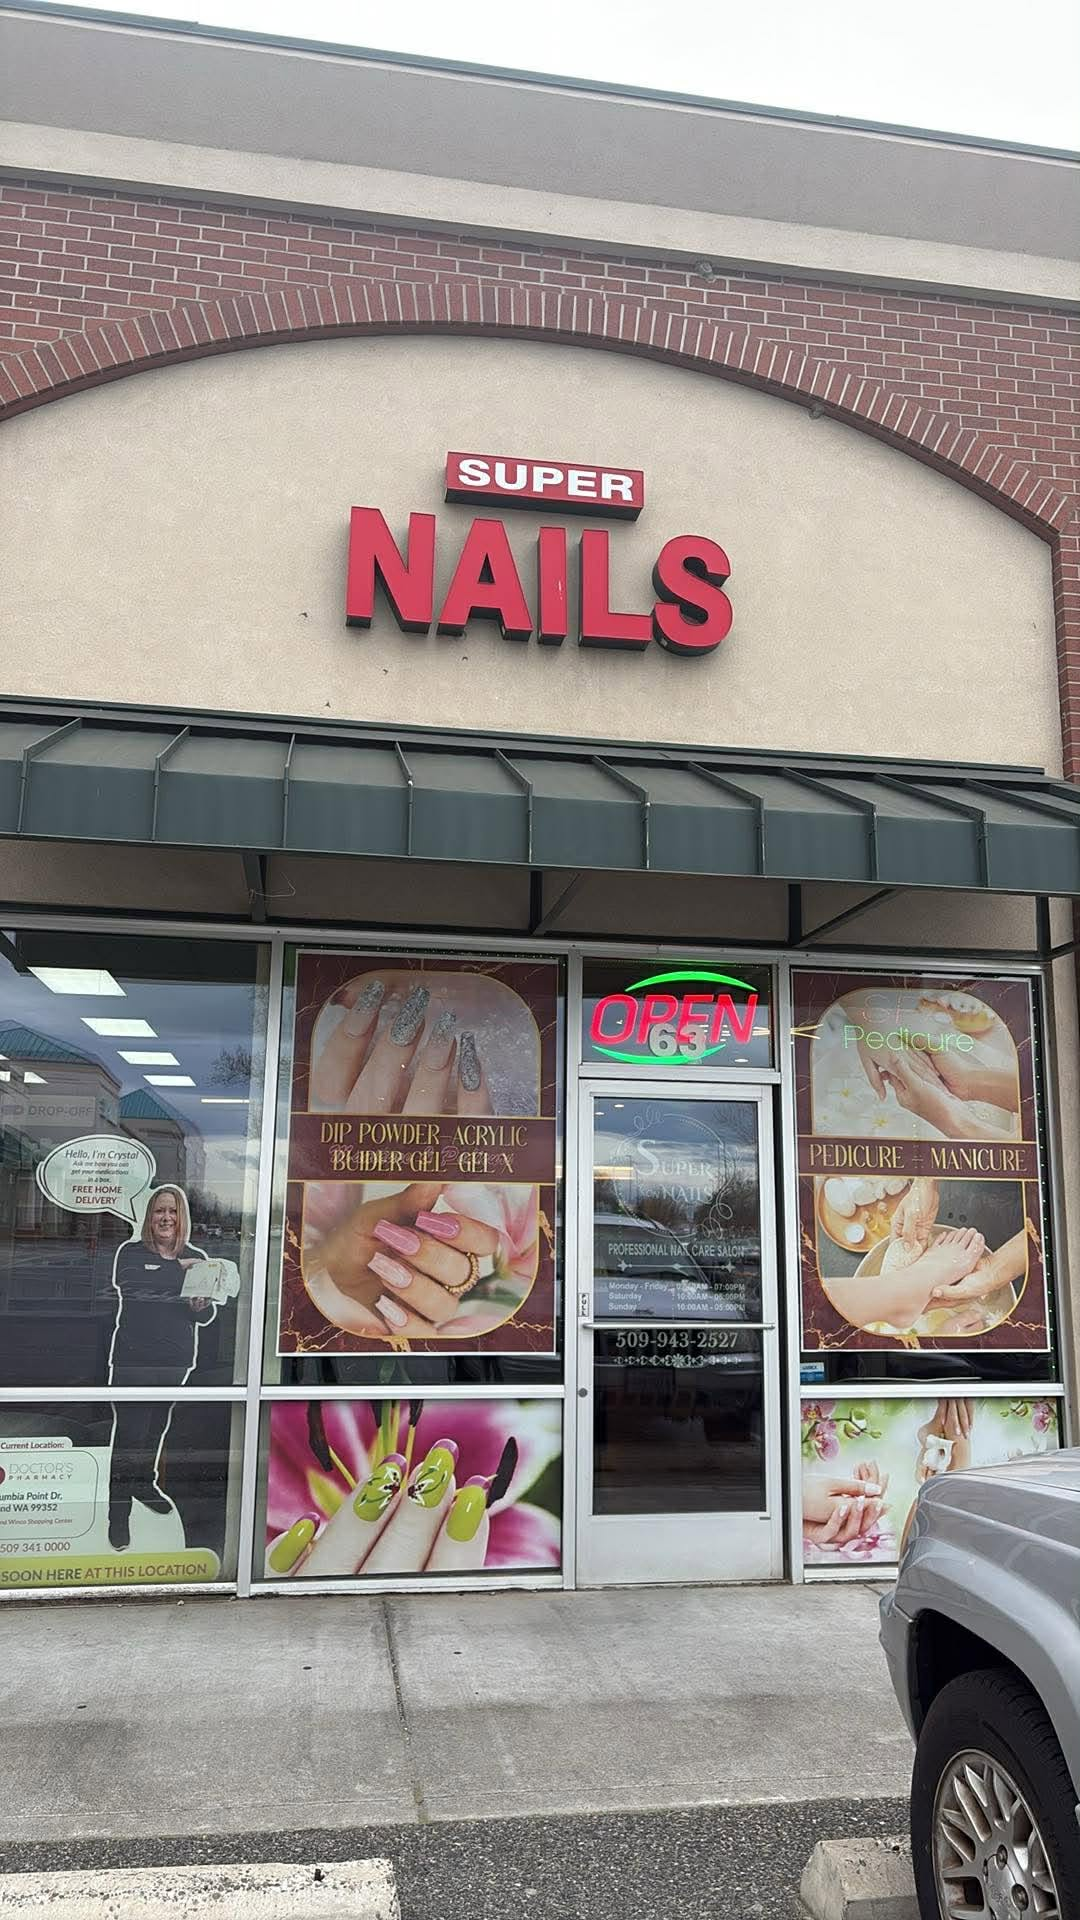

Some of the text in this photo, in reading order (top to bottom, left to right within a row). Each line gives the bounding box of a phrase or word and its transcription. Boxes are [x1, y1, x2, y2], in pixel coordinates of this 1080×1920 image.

[458, 459, 634, 501] SUPER
[346, 506, 733, 655] NAILS
[590, 994, 760, 1045] OPEN
[649, 1023, 706, 1060] 63
[842, 1025, 975, 1053] Pedicure
[321, 1122, 351, 1144] DIP
[65, 1150, 139, 1160] Hello, I'm Crystal
[333, 1150, 402, 1171] BUIDER
[501, 1153, 514, 1173] X
[810, 1144, 904, 1169] PEDICURE
[931, 1147, 1027, 1172] MANICURE
[76, 1196, 117, 1204] DELIVERY
[608, 1243, 668, 1256] PROFESSIONAL
[692, 1245, 715, 1257] CARE
[717, 1245, 745, 1257] SALON
[609, 1282, 638, 1291] Monday
[645, 1282, 668, 1291] Friday
[609, 1292, 642, 1301] Saturday
[609, 1303, 637, 1312] Sunday
[677, 1303, 708, 1311] 10:00AM
[616, 1331, 738, 1349] 509-943-2527
[9, 1462, 73, 1474] DOCTOR'S
[27, 1492, 48, 1500] Point
[13, 1504, 29, 1512] WA
[31, 1503, 58, 1512] 99352
[28, 1518, 53, 1526] Shopping
[0, 1542, 70, 1553] 509 341 0000
[1, 1563, 207, 1583] SOON HERE AT THIS LOCATION
